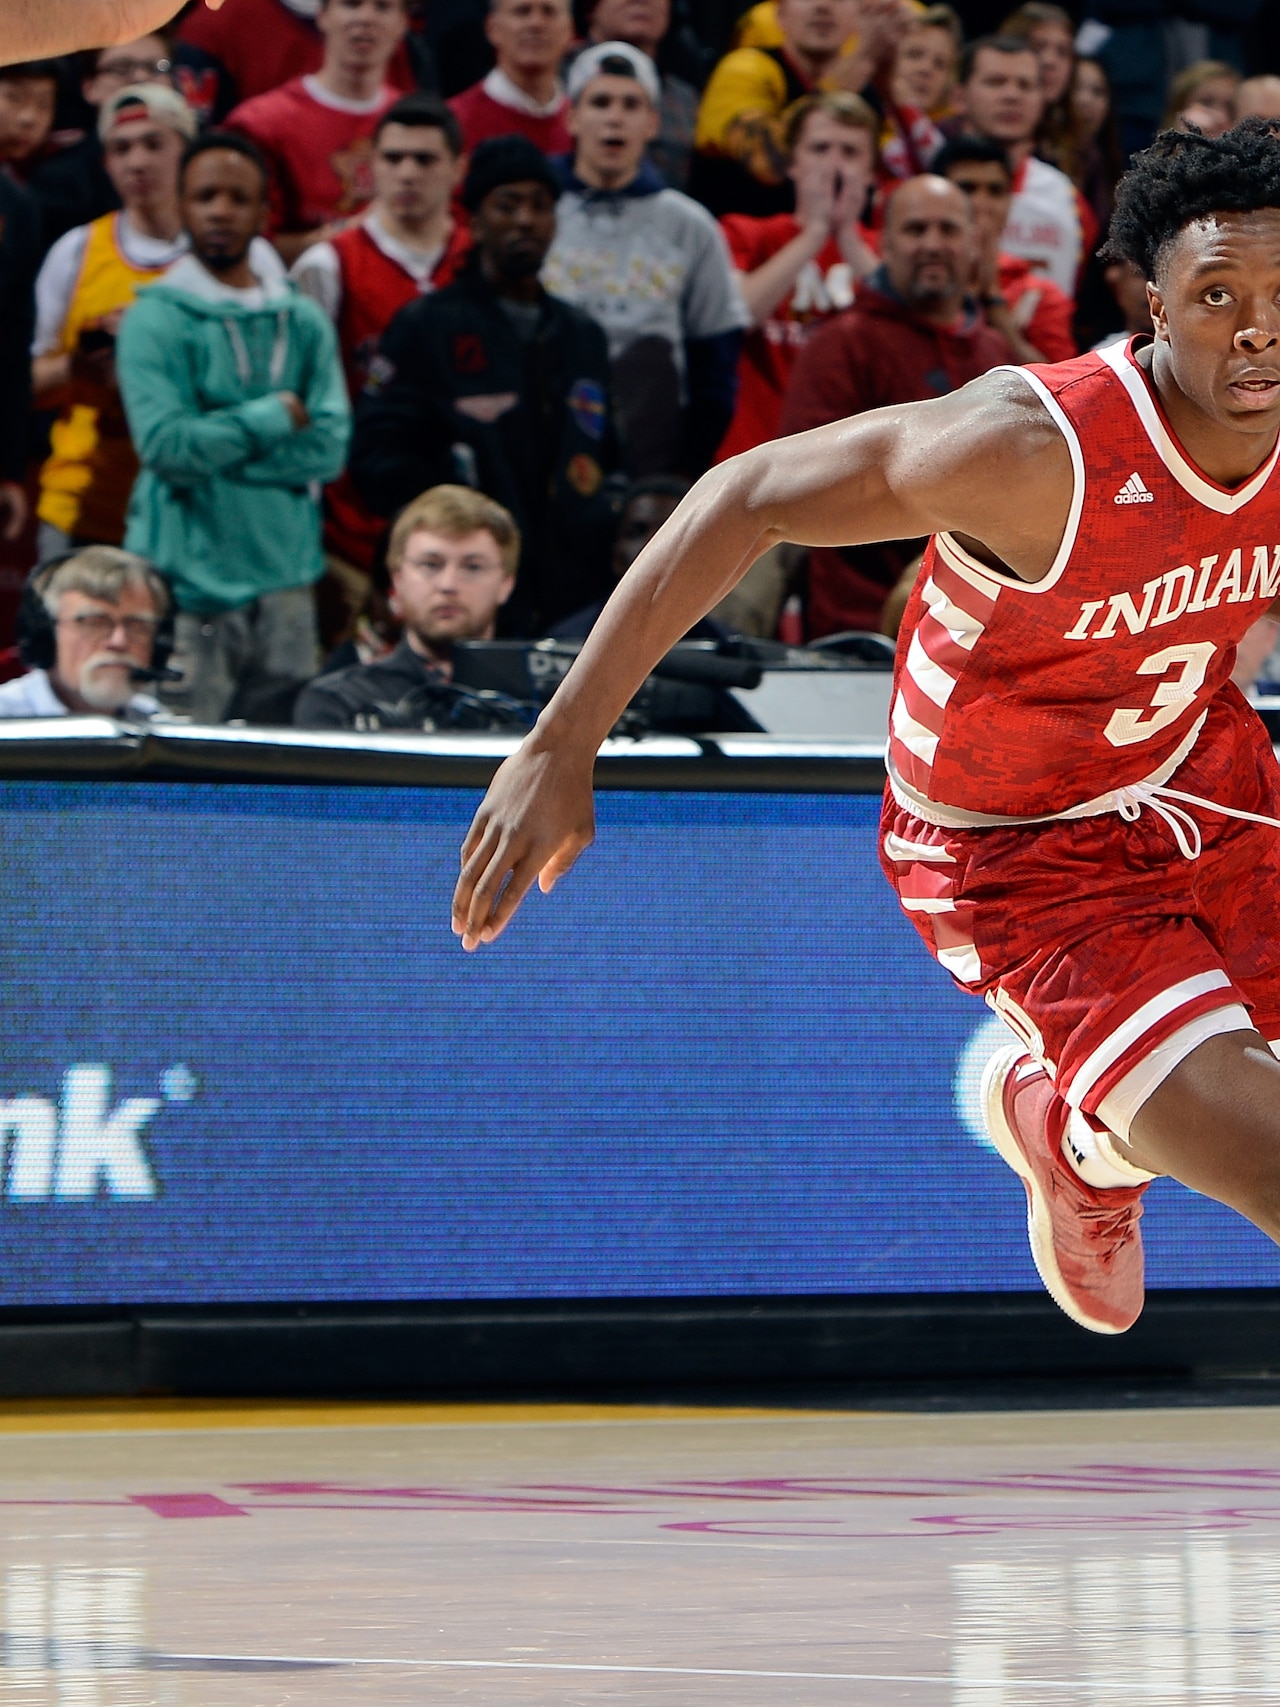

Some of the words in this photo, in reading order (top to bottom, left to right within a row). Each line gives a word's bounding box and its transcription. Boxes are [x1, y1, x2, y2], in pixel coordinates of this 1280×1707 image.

[1114, 490, 1154, 505] adidas
[1103, 641, 1218, 748] 3
[0, 1062, 161, 1202] nk
